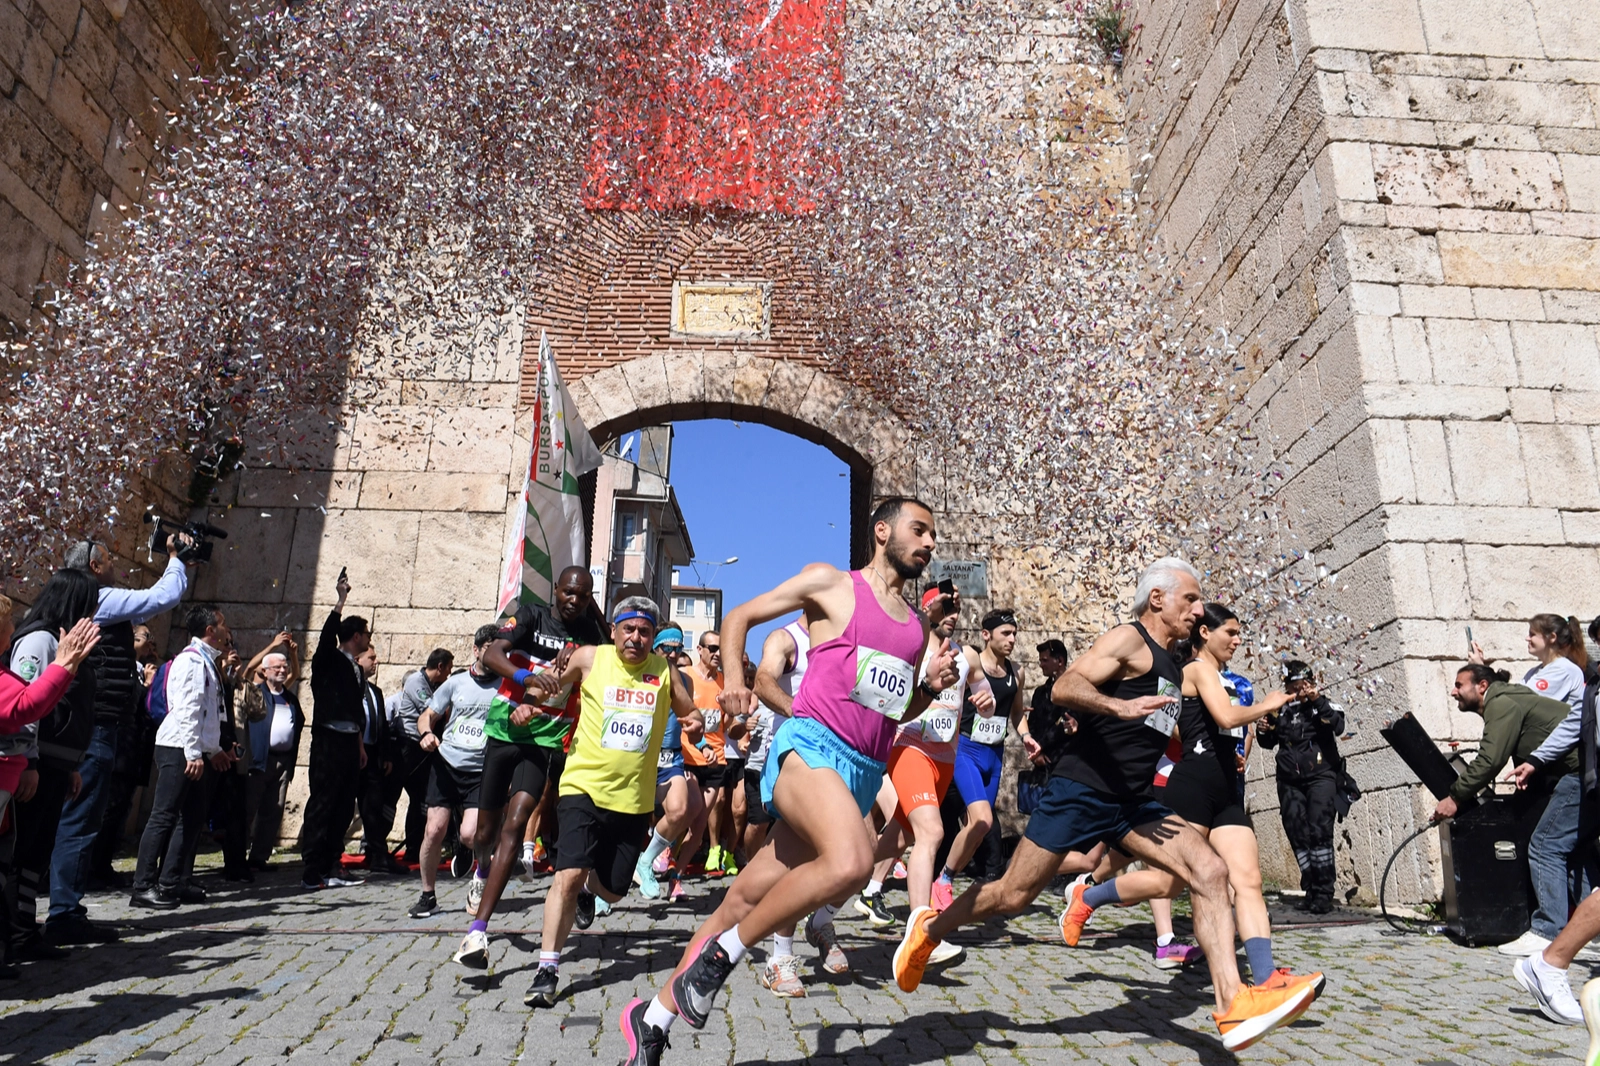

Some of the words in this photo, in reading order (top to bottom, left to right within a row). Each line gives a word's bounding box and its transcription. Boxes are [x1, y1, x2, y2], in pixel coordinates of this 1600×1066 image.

[538, 365, 551, 474] BURSASPOR
[943, 564, 975, 572] SALTANAT
[870, 666, 906, 697] 1005
[615, 688, 655, 706] BTSO
[707, 715, 717, 725] 23
[930, 718, 952, 730] 1050
[458, 724, 483, 738] 0569
[611, 721, 644, 738] 0648
[978, 722, 1001, 734] 0918
[660, 751, 672, 763] 57
